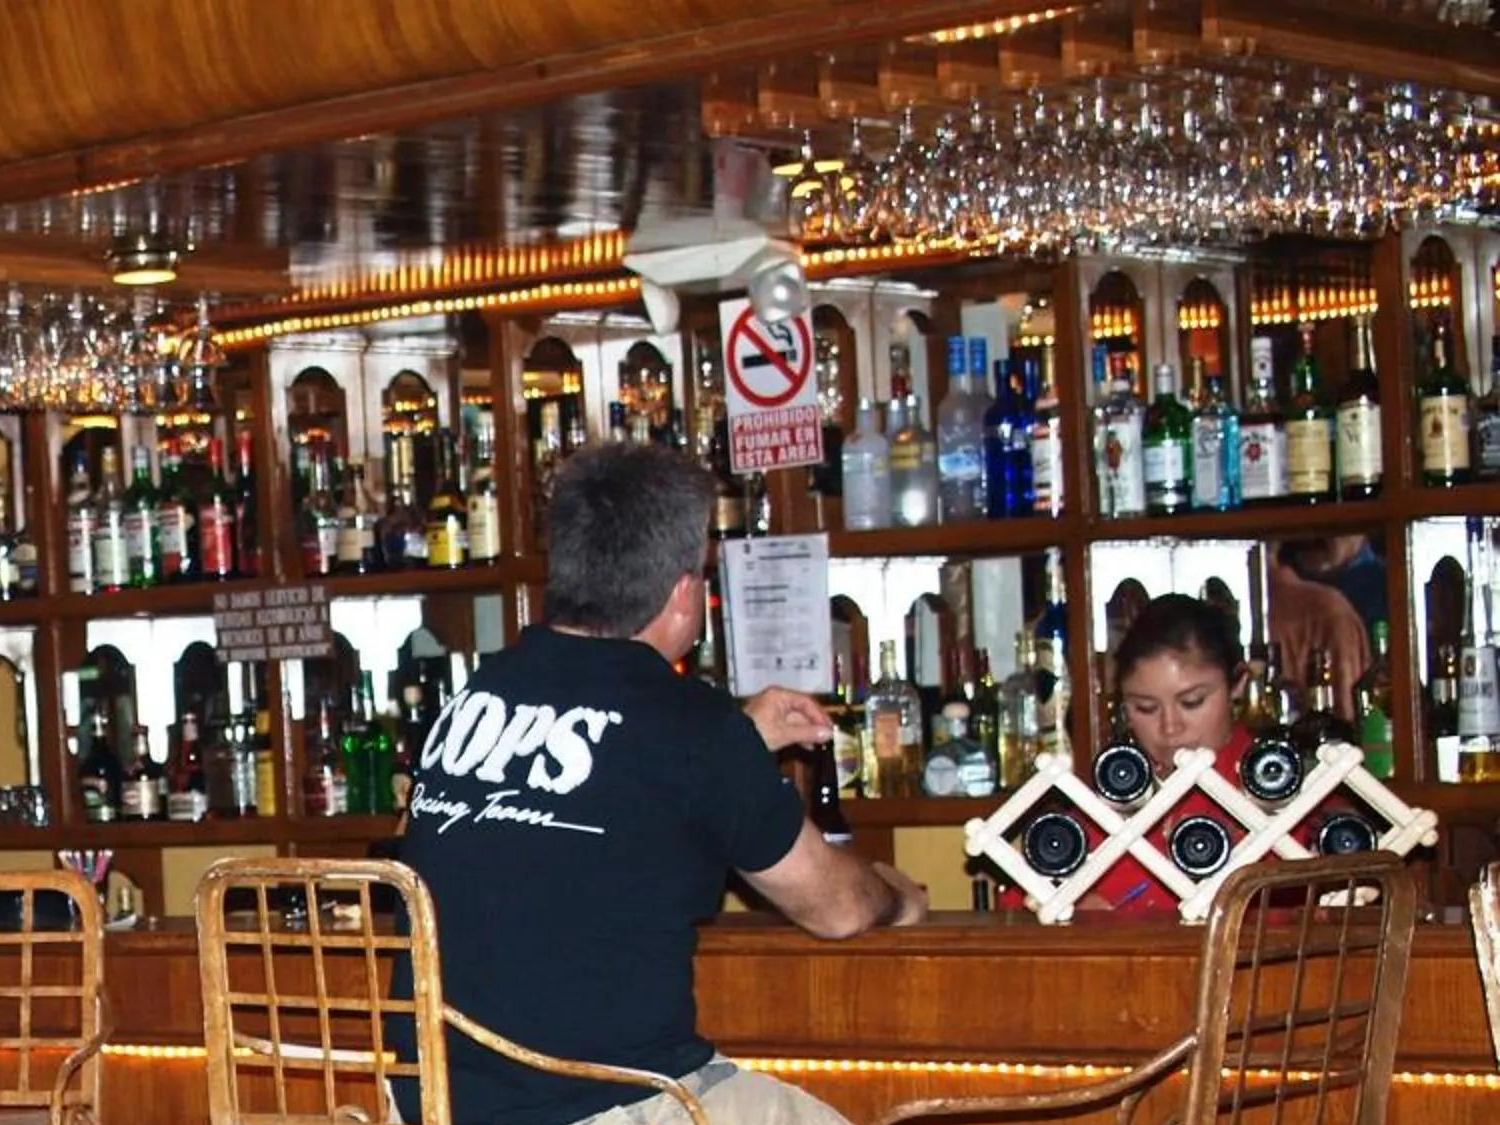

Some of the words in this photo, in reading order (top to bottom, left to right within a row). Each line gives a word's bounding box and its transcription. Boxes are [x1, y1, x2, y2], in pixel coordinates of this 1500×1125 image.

[734, 407, 815, 432] PROHIBIDO
[736, 430, 791, 451] FUMAR
[795, 426, 815, 444] EN
[736, 448, 774, 469] ESTA
[778, 442, 817, 462] AREA
[421, 689, 607, 794] COPS
[411, 782, 471, 834] Racing
[474, 790, 604, 833] Team
